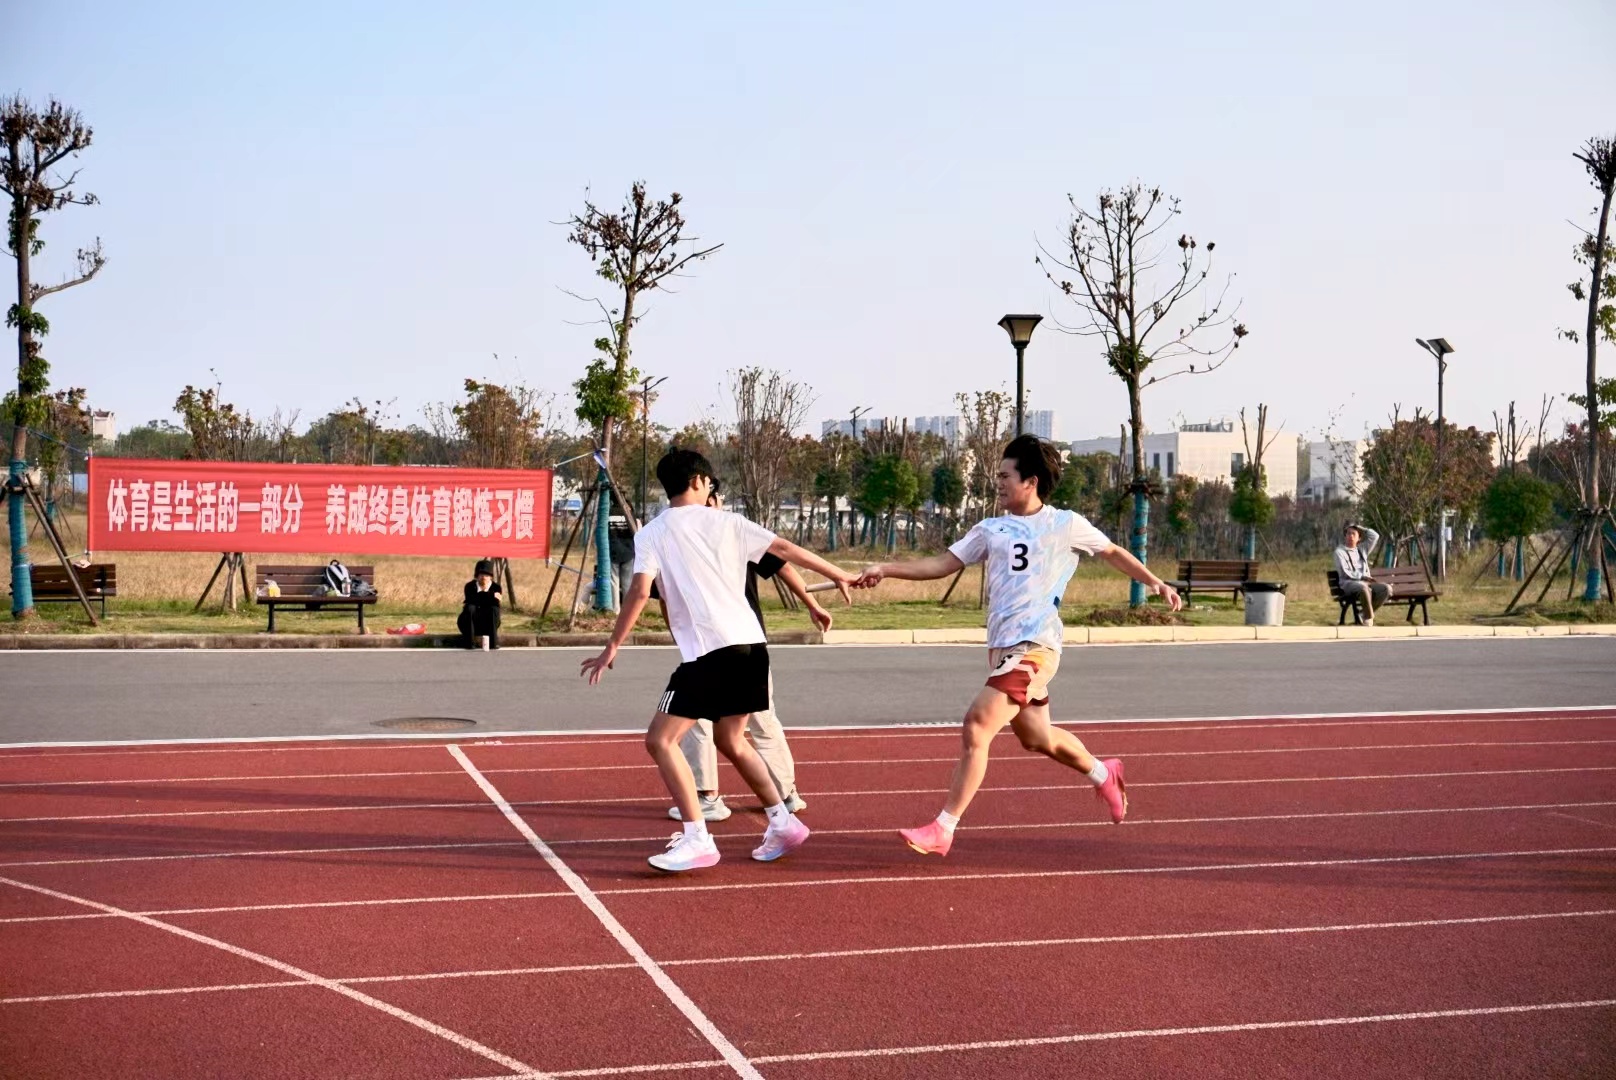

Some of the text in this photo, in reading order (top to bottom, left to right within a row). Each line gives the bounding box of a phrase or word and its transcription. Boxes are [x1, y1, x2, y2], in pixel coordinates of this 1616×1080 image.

[107, 478, 535, 540] 体育是生活的一部分 养成终身体育锻炼习惯
[1012, 543, 1029, 572] 3
